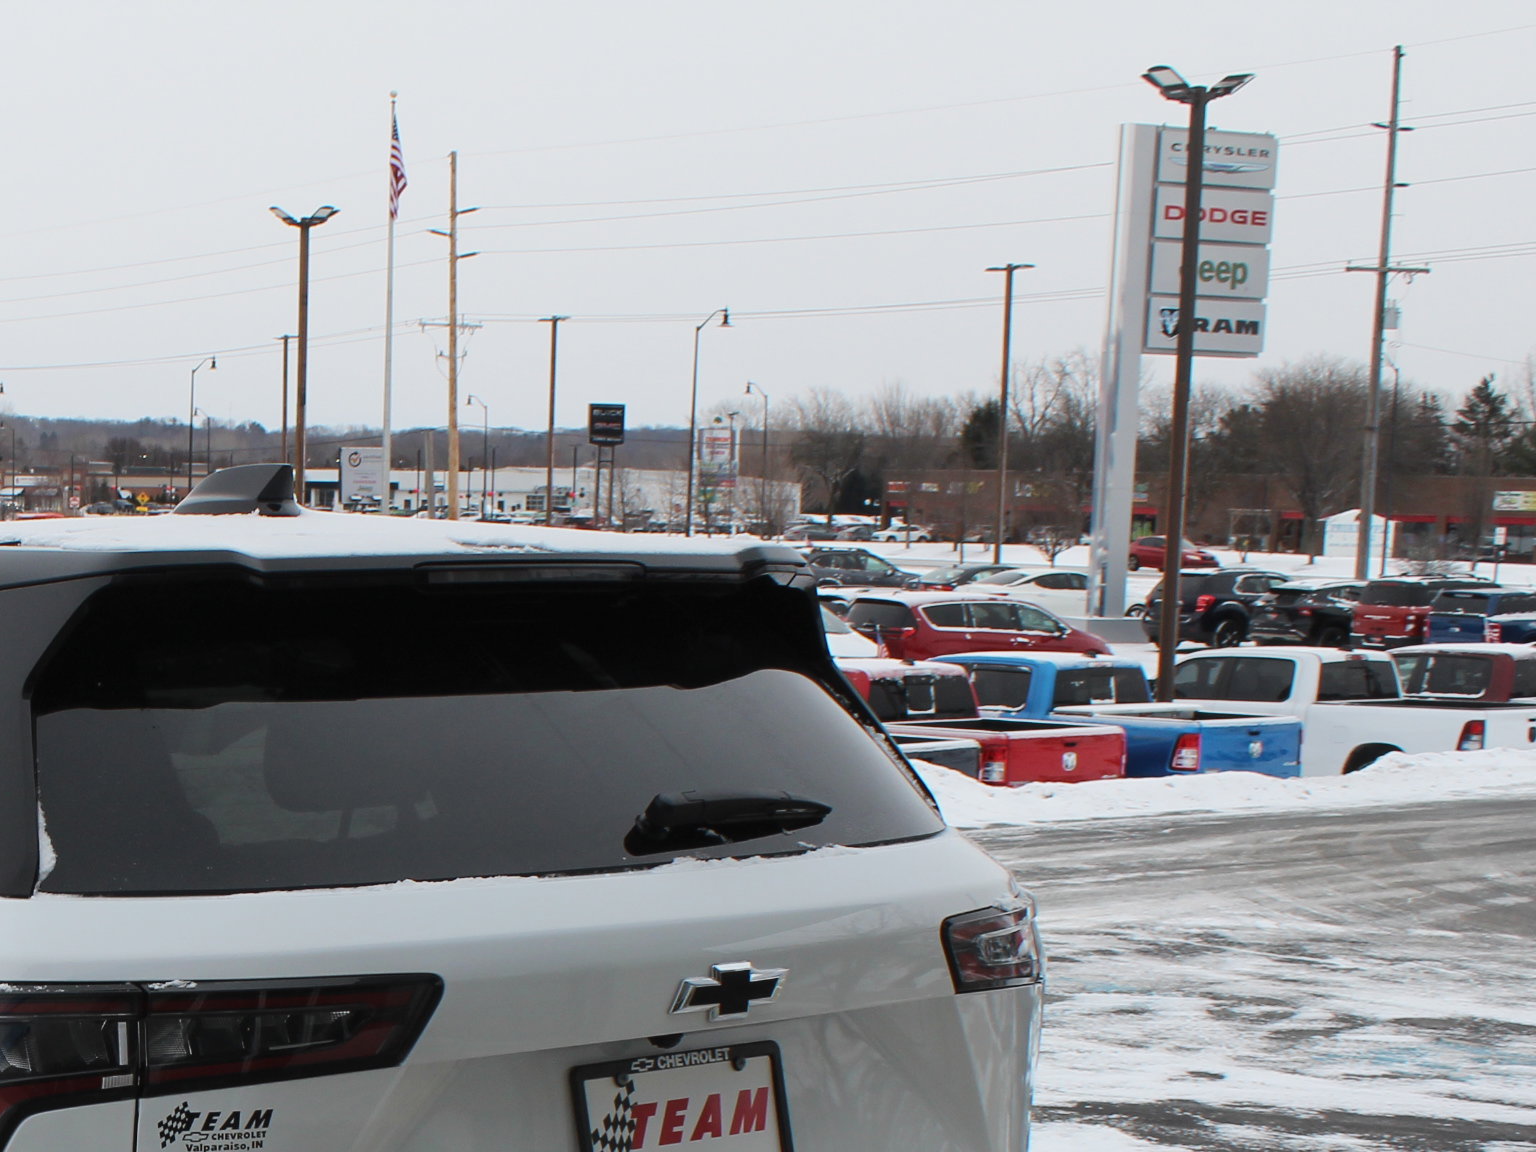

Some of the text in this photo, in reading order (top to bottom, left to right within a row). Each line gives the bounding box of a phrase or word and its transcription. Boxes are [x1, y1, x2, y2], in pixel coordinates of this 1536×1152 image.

[1170, 142, 1271, 158] CRYSLER
[1181, 259, 1249, 290] eep
[1192, 317, 1261, 336] RAM
[657, 1047, 731, 1069] CHEVROLET
[182, 1108, 274, 1132] TEAM
[630, 1086, 769, 1151] TEAM
[211, 1130, 267, 1141] CHEVROLET
[251, 1140, 264, 1150] IN
